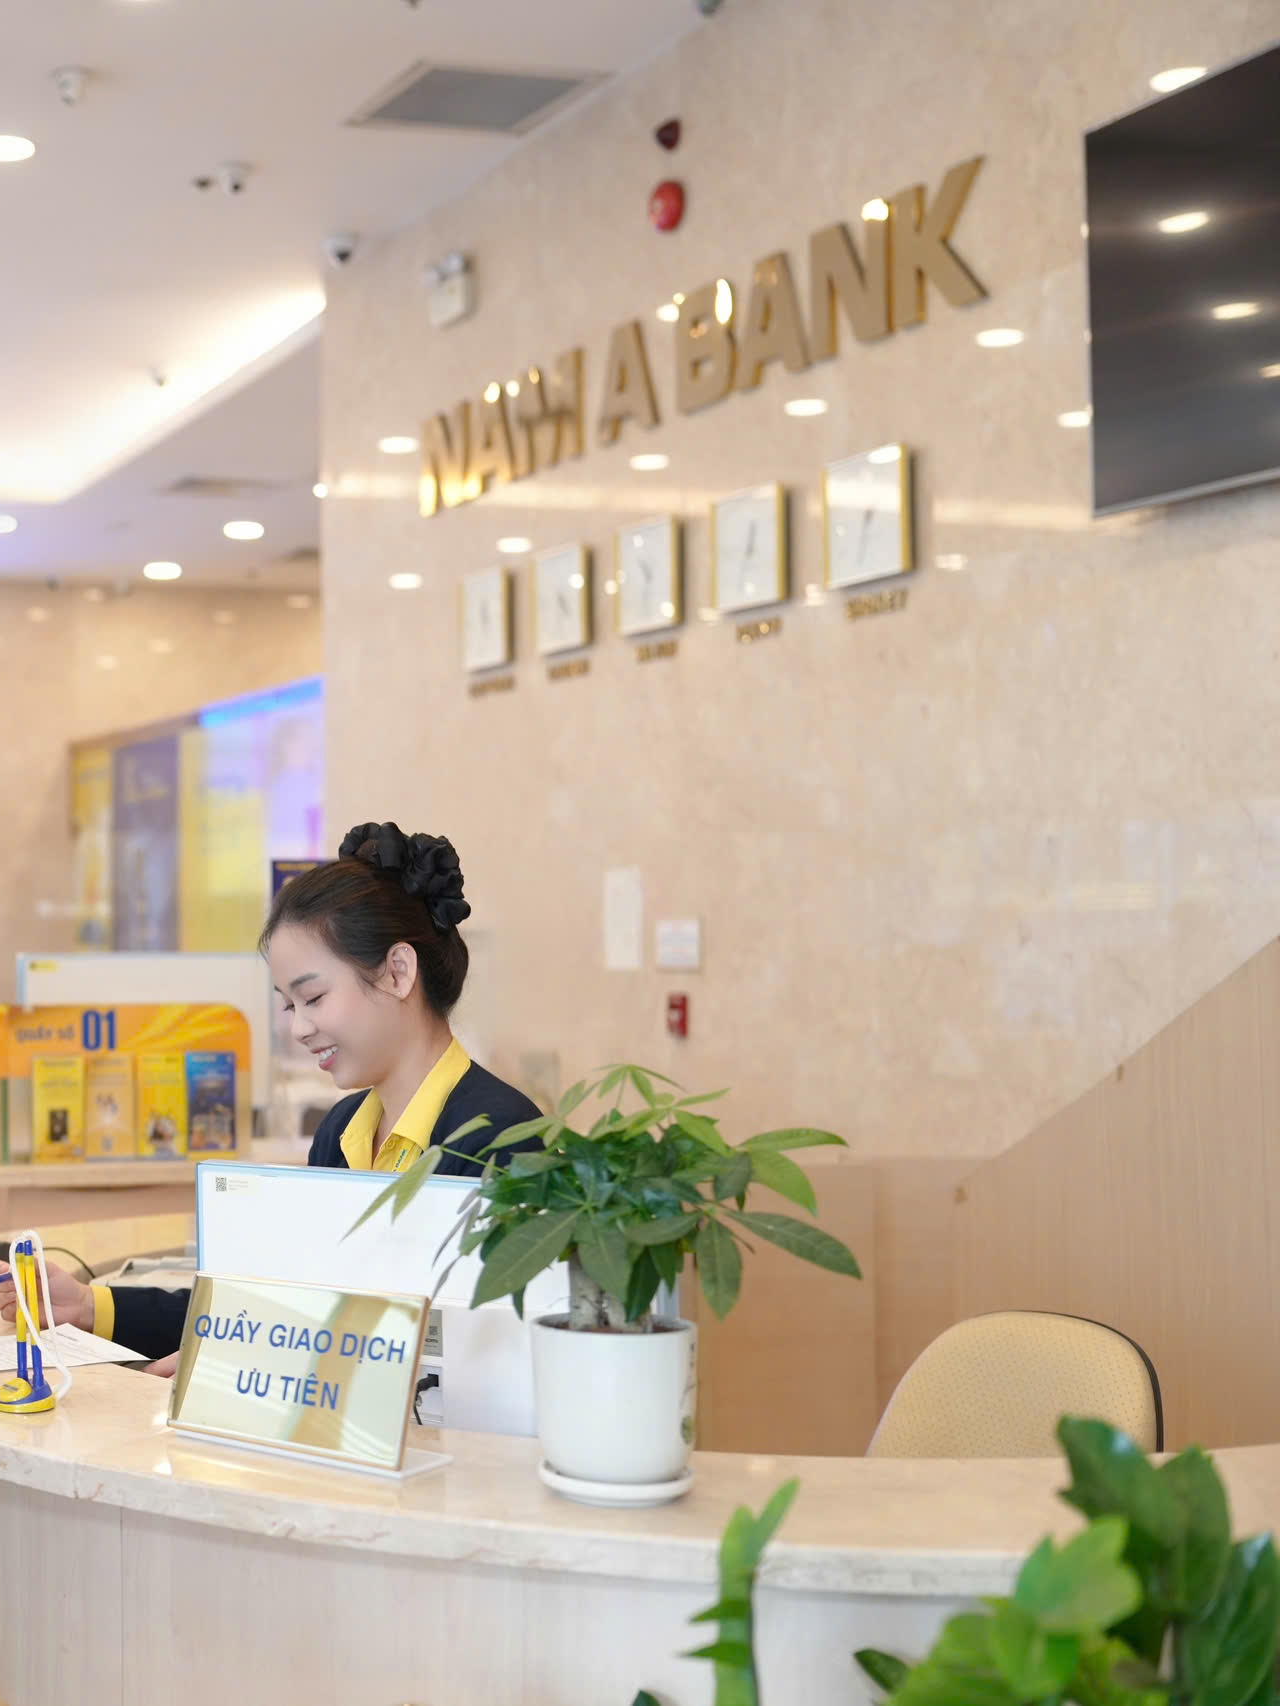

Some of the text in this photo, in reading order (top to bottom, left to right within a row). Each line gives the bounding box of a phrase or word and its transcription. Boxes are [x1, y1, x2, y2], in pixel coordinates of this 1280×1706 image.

[419, 154, 991, 517] NAM A BANK
[82, 1009, 116, 1051] 01
[193, 1309, 407, 1364] QUẦY GIAO DỊCH
[235, 1367, 340, 1410] ƯU TIÊN
